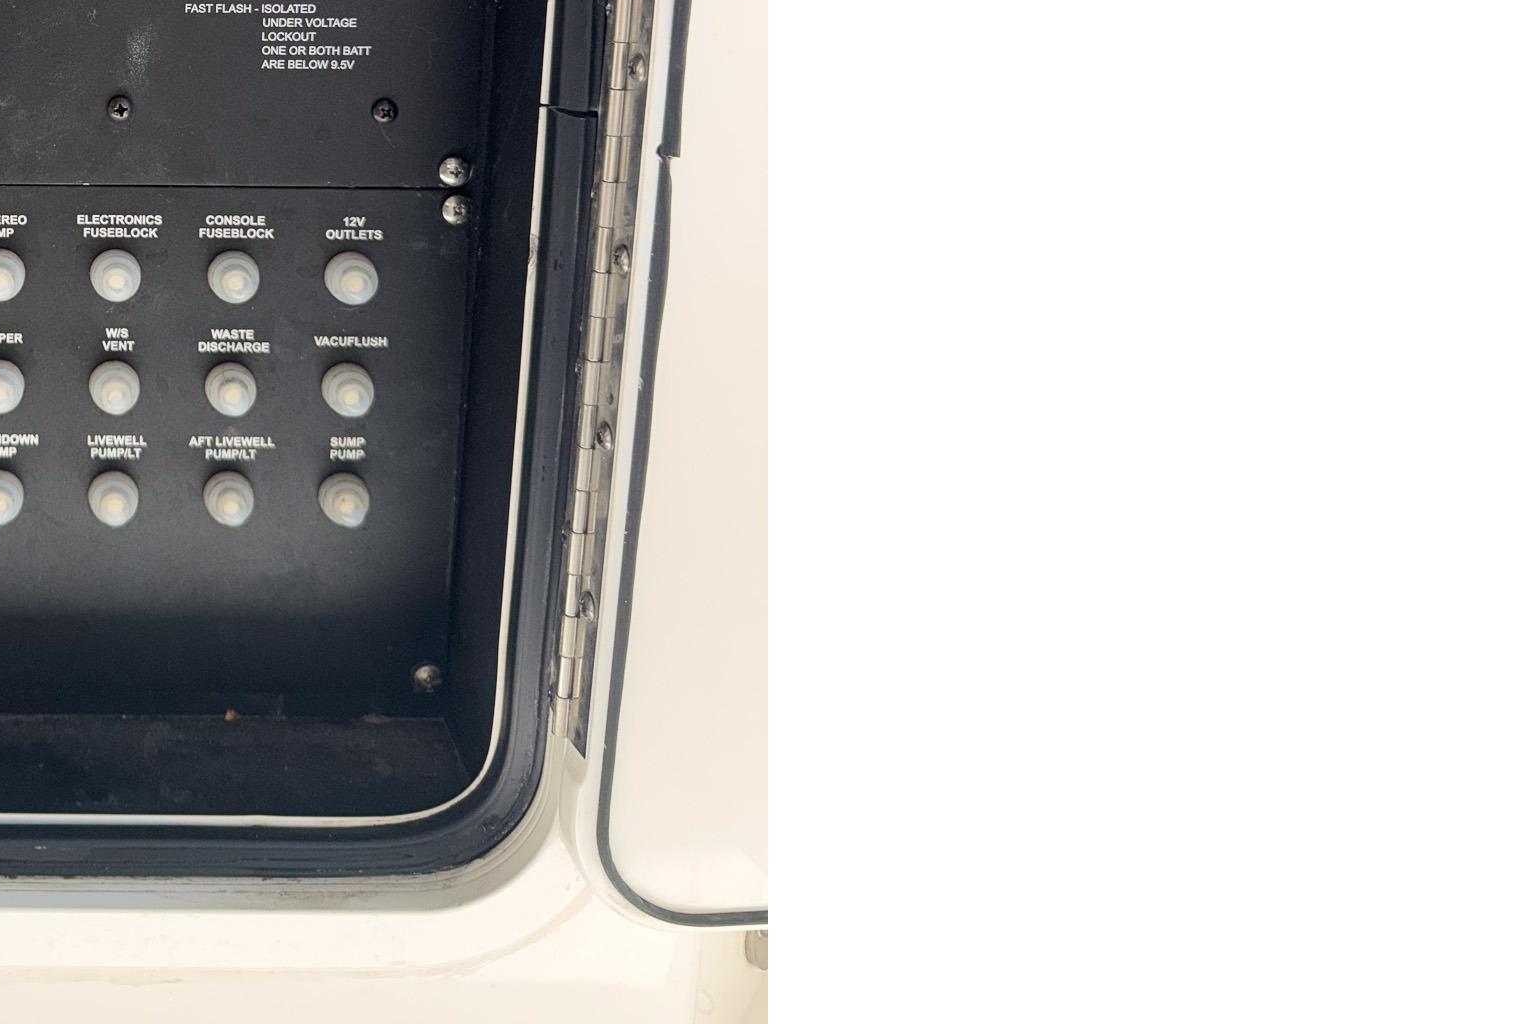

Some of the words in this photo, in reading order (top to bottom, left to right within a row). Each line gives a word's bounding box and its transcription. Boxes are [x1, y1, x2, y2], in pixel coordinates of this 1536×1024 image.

[184, 3, 214, 14] FAST
[215, 3, 252, 14] FLASH
[261, 3, 317, 14] ISOLATED
[262, 17, 304, 28] UNDER
[304, 17, 358, 28] VOLTAGE
[261, 31, 317, 42] LOCKOUT
[261, 45, 287, 56] ONE
[288, 45, 307, 56] OR
[308, 45, 341, 56] BOTH
[342, 45, 372, 56] BATT
[260, 59, 286, 70] ARE
[287, 59, 330, 70] BELOW
[330, 59, 356, 70] 9.5V
[76, 214, 163, 226] ELECTRONICS
[205, 214, 266, 227] CONSOLE
[342, 216, 367, 228] 12V
[83, 227, 159, 239] FUSEBLOCK
[198, 227, 275, 240] FUSEBLOCK
[325, 228, 384, 241] OUTLETS
[105, 327, 130, 339] W/S
[210, 328, 255, 341] WASTE
[101, 340, 136, 352] VENT
[197, 341, 271, 354] DISCHARGE
[313, 335, 388, 348] VACUFLUSH
[87, 434, 148, 447] LIVEWELL
[188, 435, 213, 448] AFT
[215, 435, 276, 449] LIVEWELL
[329, 436, 366, 448] SUMP
[90, 447, 142, 460] PUMP/LT
[204, 448, 257, 461] PUMP/LT
[329, 448, 366, 461] PUMP
